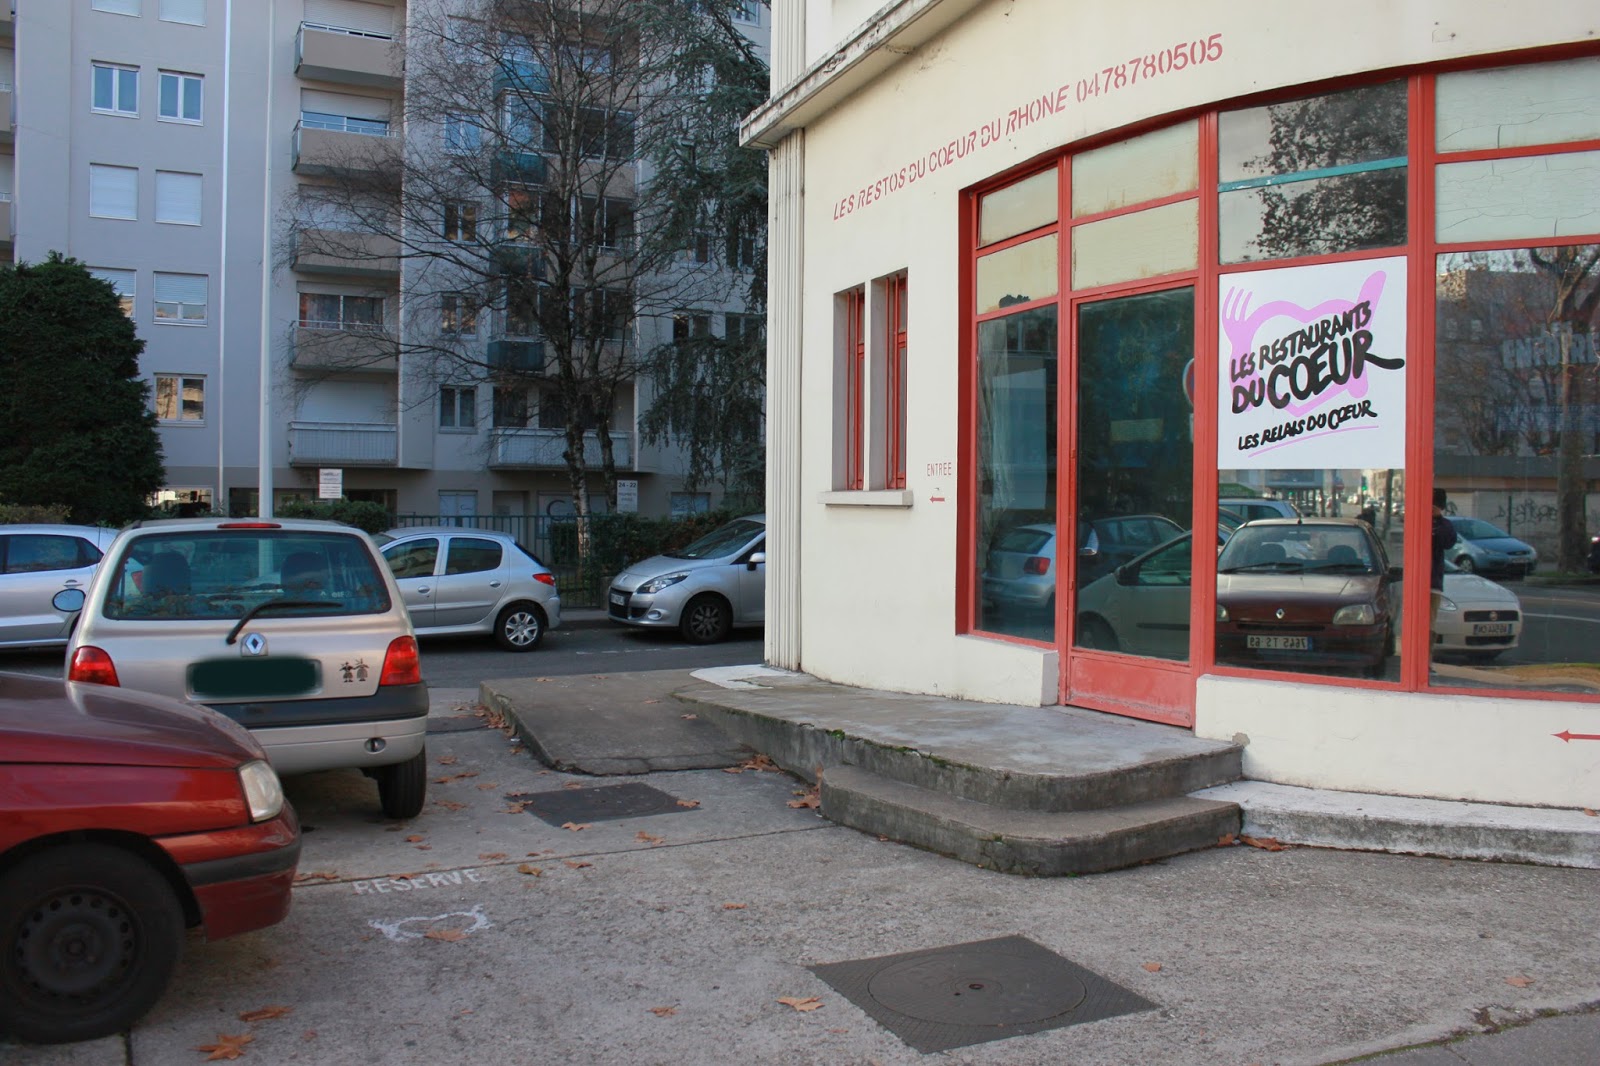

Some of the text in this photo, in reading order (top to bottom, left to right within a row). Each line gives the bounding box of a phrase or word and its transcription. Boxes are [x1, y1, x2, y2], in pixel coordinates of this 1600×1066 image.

[833, 33, 1224, 221] LES RESTOS DU COEUR DU RHONE 0478780505
[1231, 300, 1372, 383] LES RESTAURANTS
[1231, 329, 1405, 414] DU COEUR
[1238, 433, 1260, 451] LES
[1260, 419, 1306, 446] RELAIS
[1306, 413, 1327, 432] DU
[926, 462, 952, 477] ENTREE
[351, 868, 482, 896] RESERVE
